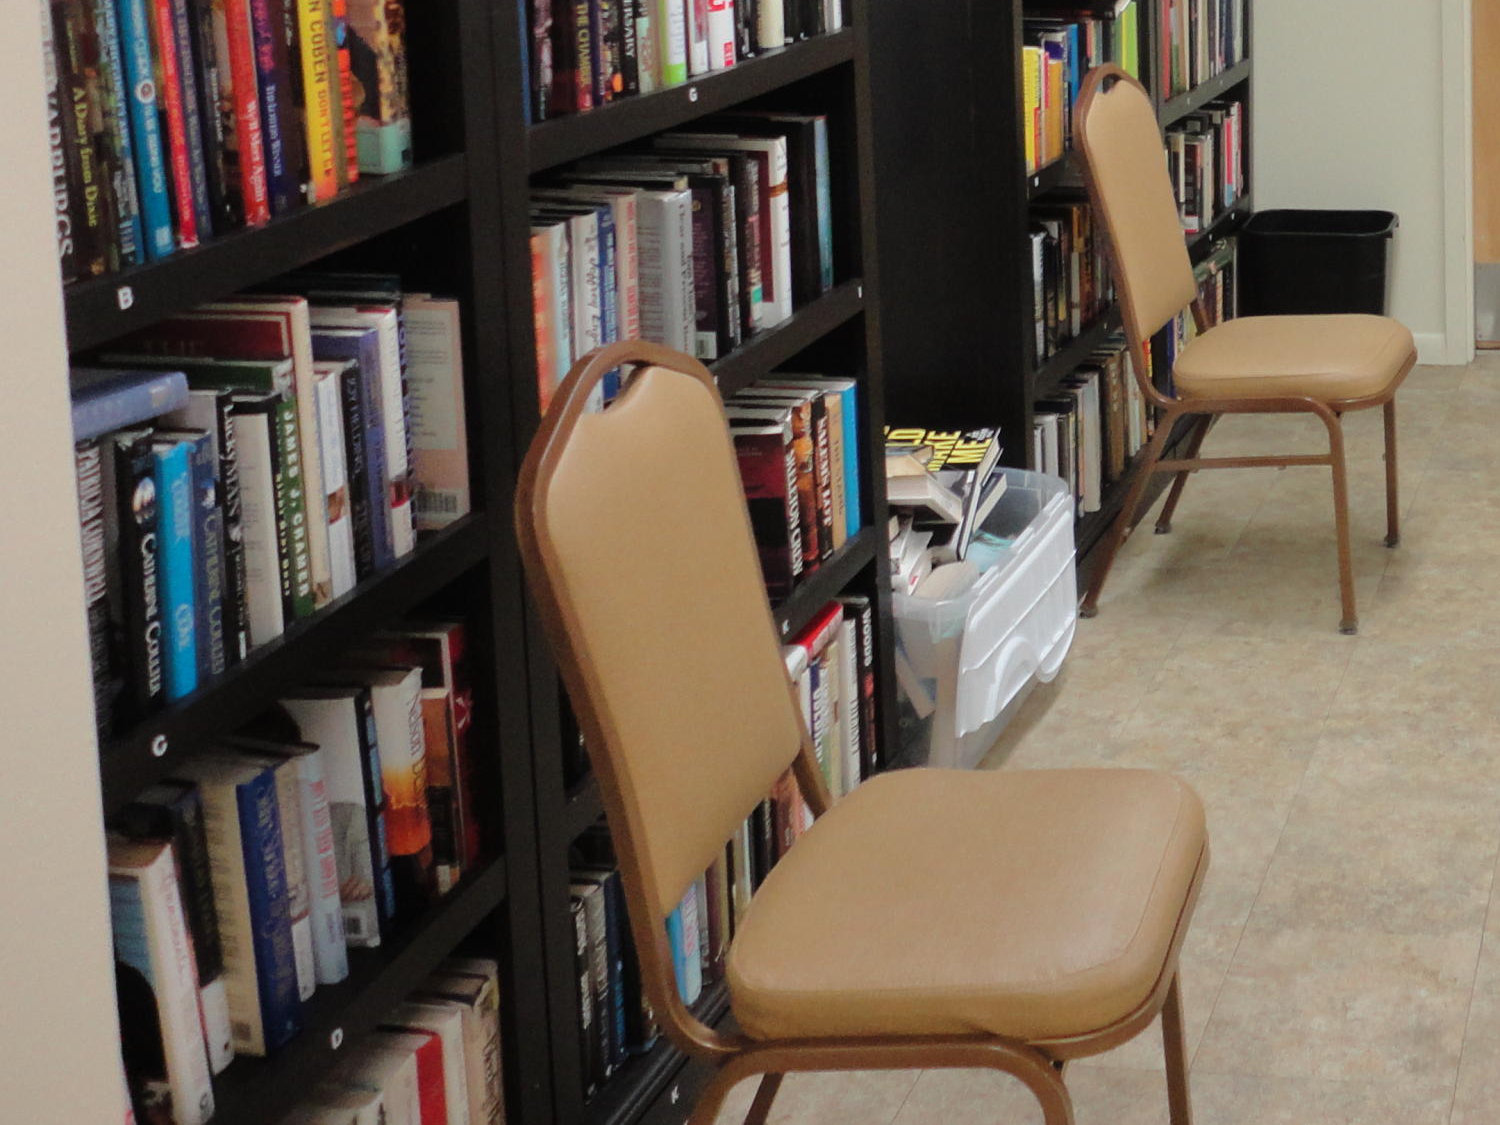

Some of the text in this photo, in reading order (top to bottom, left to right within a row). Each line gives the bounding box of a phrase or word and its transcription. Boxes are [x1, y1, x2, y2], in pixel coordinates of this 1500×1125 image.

[575, 3, 588, 27] THE
[311, 19, 328, 84] COBEN
[688, 87, 699, 103] G
[117, 286, 135, 311] B
[946, 437, 992, 464] ME
[282, 410, 299, 477] JAMES
[292, 512, 310, 597] CRAMER
[784, 449, 804, 576] SKELETON CREW
[140, 533, 163, 697] CATHERINE COULTER
[863, 607, 872, 667] WOODS
[407, 699, 425, 757] Nelson
